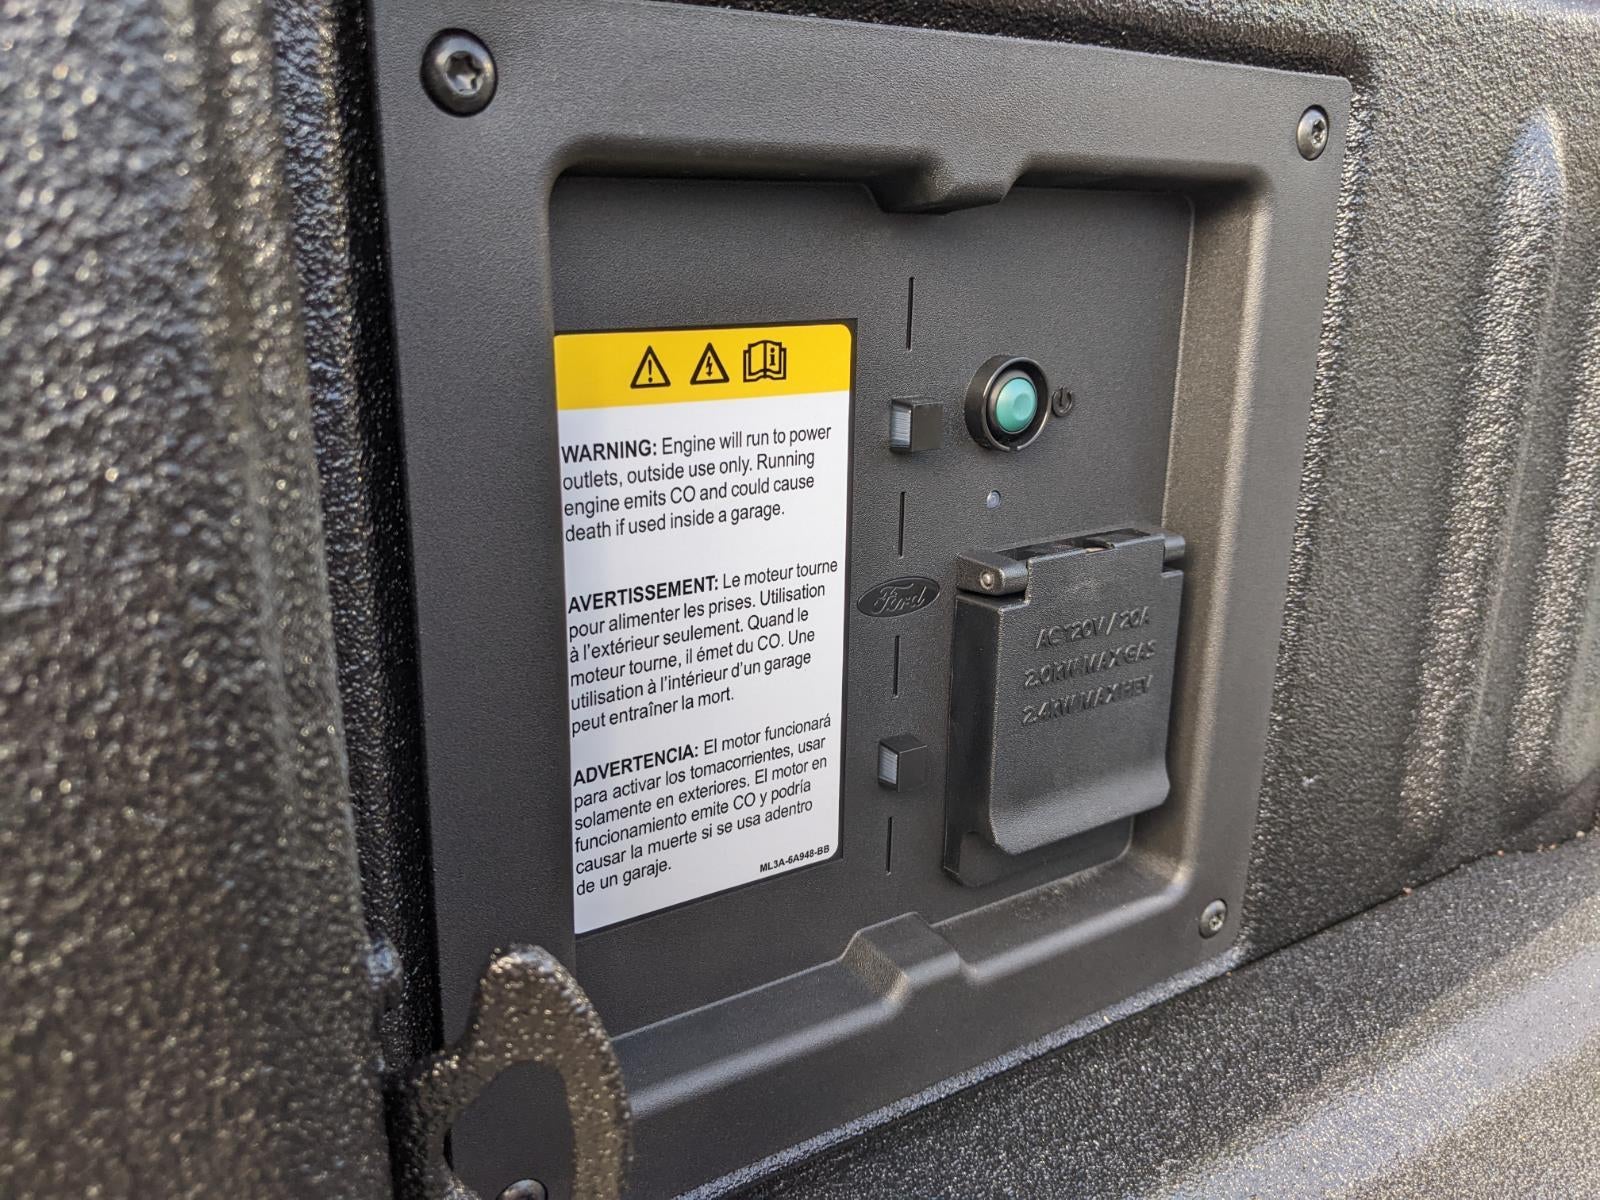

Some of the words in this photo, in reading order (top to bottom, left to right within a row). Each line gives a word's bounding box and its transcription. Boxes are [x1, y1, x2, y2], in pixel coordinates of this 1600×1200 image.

[561, 438, 658, 465] WARNING:
[661, 434, 716, 458] Engine
[718, 430, 743, 450] will
[746, 432, 770, 448] run
[772, 428, 787, 445] to
[789, 426, 832, 448] power
[562, 469, 623, 492] outlets,
[626, 461, 685, 485] outside
[688, 461, 716, 479] use
[718, 455, 753, 477] only.
[756, 449, 815, 471] Running
[564, 495, 620, 519] engine
[623, 489, 667, 511] emits
[669, 484, 697, 505] CO
[699, 481, 728, 502] and
[730, 476, 770, 498] could
[772, 475, 815, 493] cause
[565, 520, 612, 543] death
[615, 517, 626, 537] if
[627, 512, 666, 535] used
[669, 507, 715, 530] inside
[717, 509, 727, 524] a
[730, 503, 785, 526] garage.
[568, 574, 719, 614] AVERTISSEMENT:
[722, 572, 741, 590] Le
[743, 566, 795, 587] moteur
[795, 560, 838, 578] tourne
[568, 619, 606, 643] pour
[608, 607, 681, 632] alimenter
[683, 602, 705, 620] les
[708, 595, 757, 620] prises.
[759, 582, 826, 607] Utilisation
[872, 582, 927, 615] Ford
[569, 645, 580, 664] à
[662, 617, 744, 646] seulement.
[746, 607, 795, 632] Quand
[797, 606, 809, 623] le
[570, 665, 626, 688] moteur
[628, 654, 682, 676] tourne,
[685, 647, 693, 665] il
[696, 641, 734, 663] émet
[735, 638, 754, 656] du
[757, 632, 785, 652] CO.
[788, 628, 816, 646] Une
[571, 685, 644, 712] utilisation
[646, 678, 657, 696] à
[763, 652, 812, 676] garage
[571, 712, 607, 738] peut
[608, 699, 679, 726] entraîner
[681, 694, 695, 711] la
[697, 685, 734, 708] mort.
[572, 743, 699, 788] ADVERTENCIA:
[703, 737, 718, 756] El
[721, 731, 762, 752] motor
[764, 712, 832, 742] funcionará
[573, 789, 608, 814] para
[612, 775, 662, 800] activar
[665, 770, 687, 787] los
[689, 745, 794, 780] tomacorrientes,
[797, 736, 827, 755] usar
[574, 799, 652, 831] solamente
[655, 794, 674, 810] en
[678, 776, 750, 804] exteriores.
[754, 767, 768, 785] El
[771, 760, 810, 782] motor
[811, 756, 828, 771] en
[574, 811, 688, 854] funcionamiento
[690, 799, 730, 822] emite
[732, 791, 757, 811] CO
[759, 791, 768, 809] y
[770, 778, 812, 806] podría
[575, 849, 628, 875] causar
[630, 843, 643, 860] la
[647, 829, 698, 856] muerte
[701, 822, 713, 841] si
[716, 821, 734, 836] se
[736, 813, 761, 831] usa
[764, 800, 813, 823] adentro
[759, 844, 831, 873] ML3A-6A948-BB
[576, 879, 596, 897] de
[599, 873, 619, 890] un
[622, 858, 672, 887] garaje.
